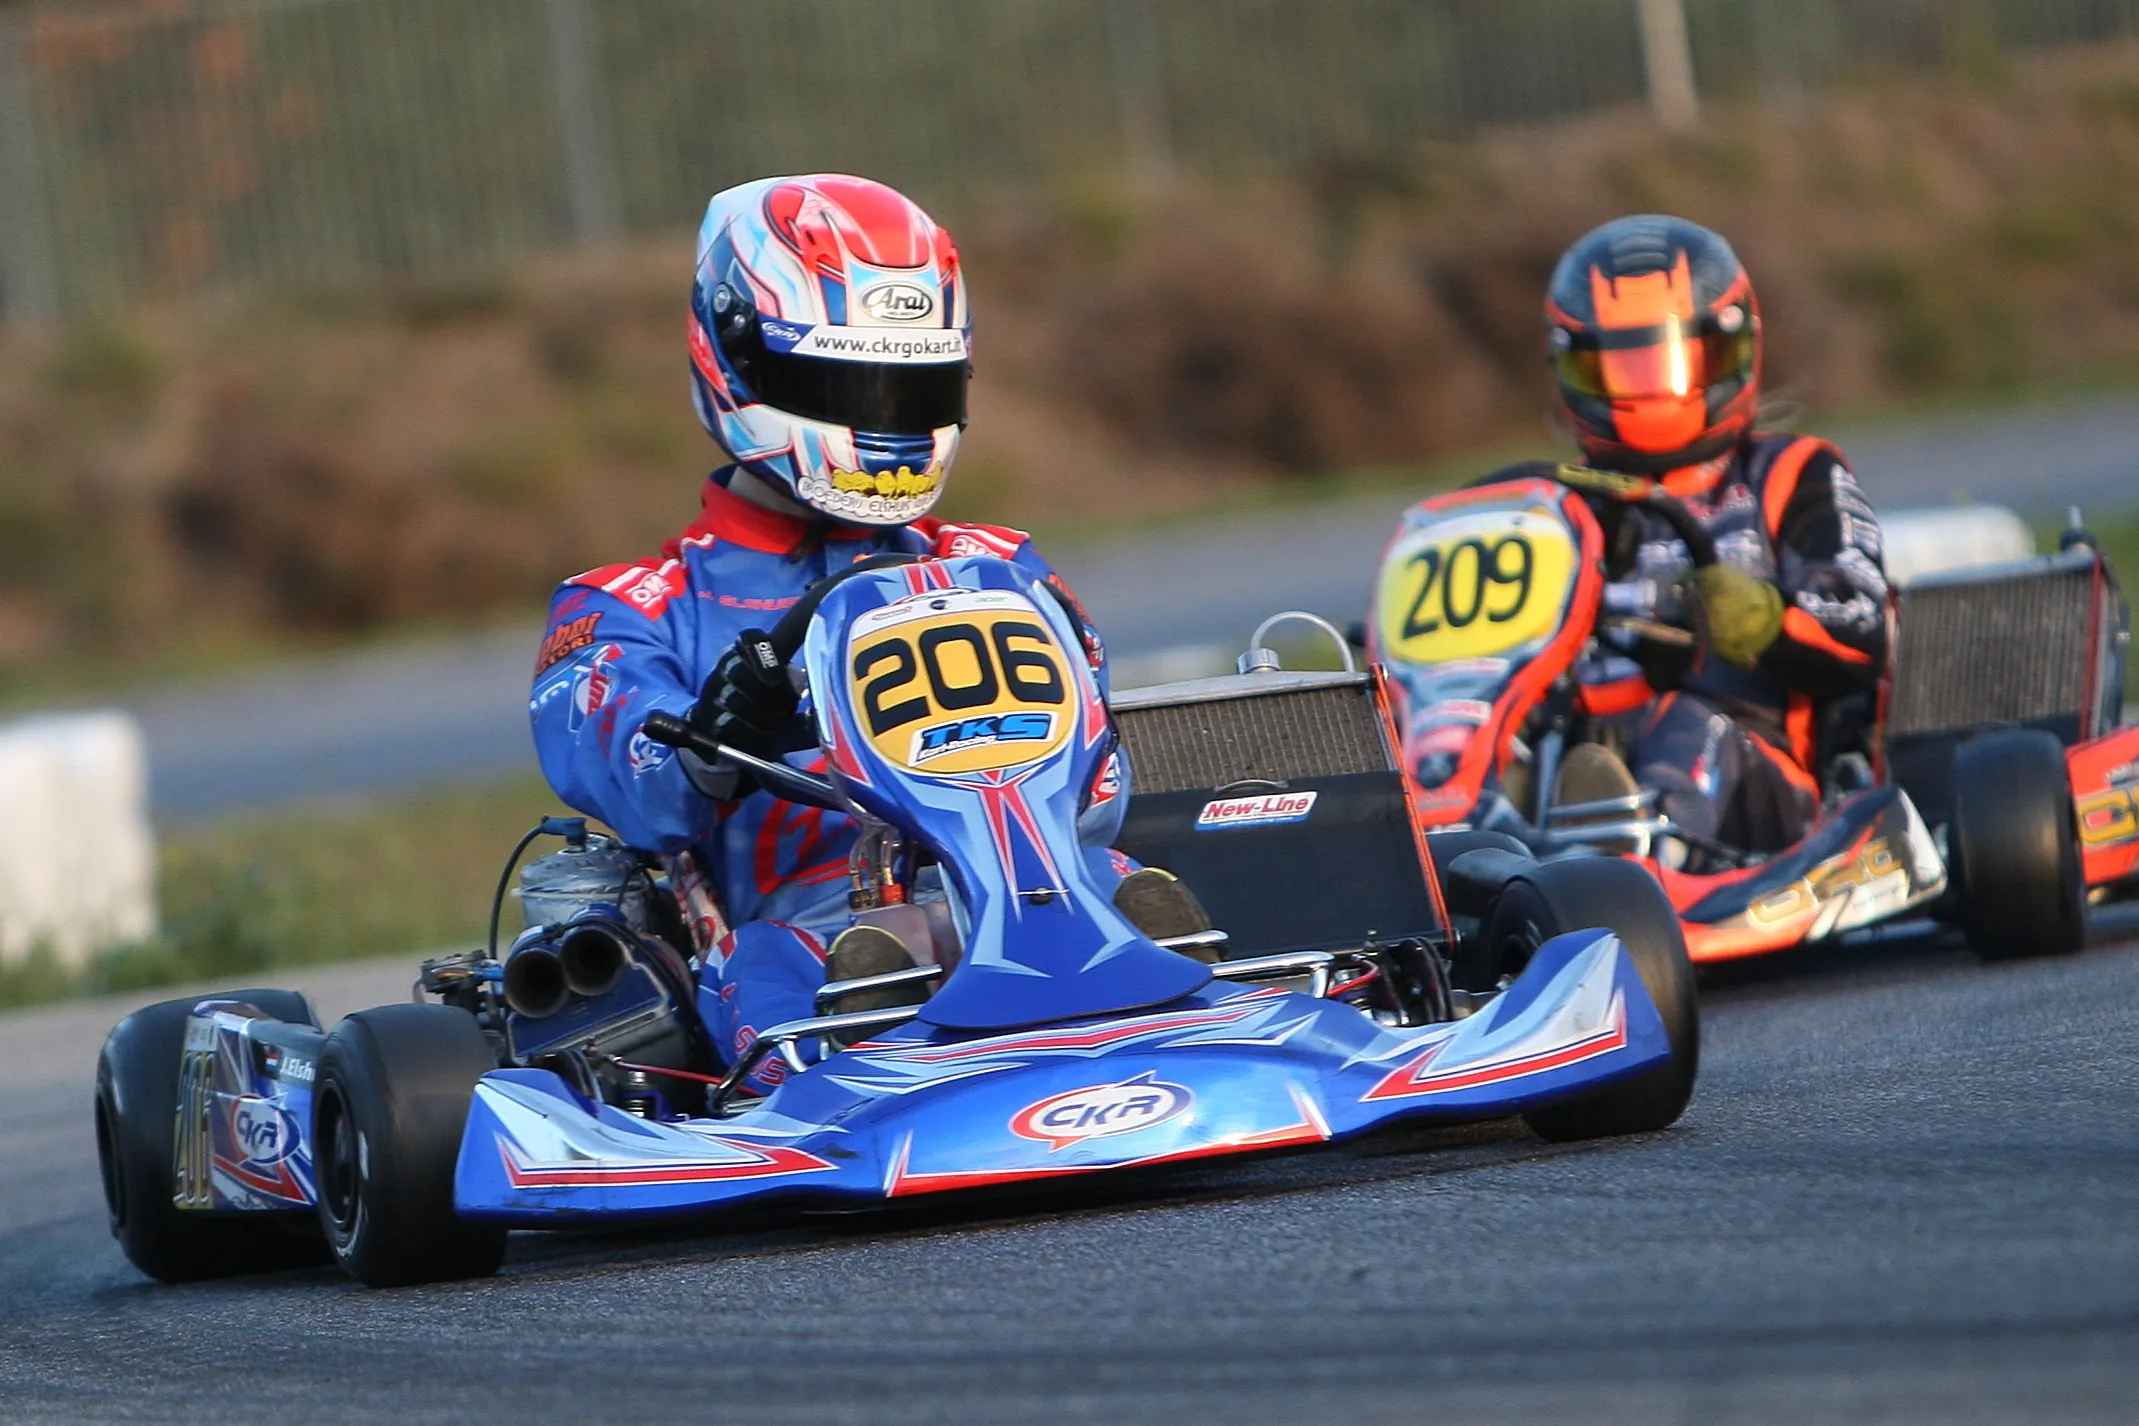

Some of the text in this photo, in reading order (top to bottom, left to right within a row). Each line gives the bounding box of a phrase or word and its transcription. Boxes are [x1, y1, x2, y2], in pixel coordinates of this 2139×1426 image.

[869, 287, 928, 310] Arai
[813, 335, 961, 358] www.ckrgokart.it
[1401, 536, 1532, 640] 209
[757, 641, 778, 669] OMP
[853, 621, 1065, 738] 206
[922, 713, 1052, 750] TKS
[1203, 797, 1309, 818] New-Line
[1042, 1094, 1162, 1128] CKR
[236, 1110, 278, 1149] CKR
